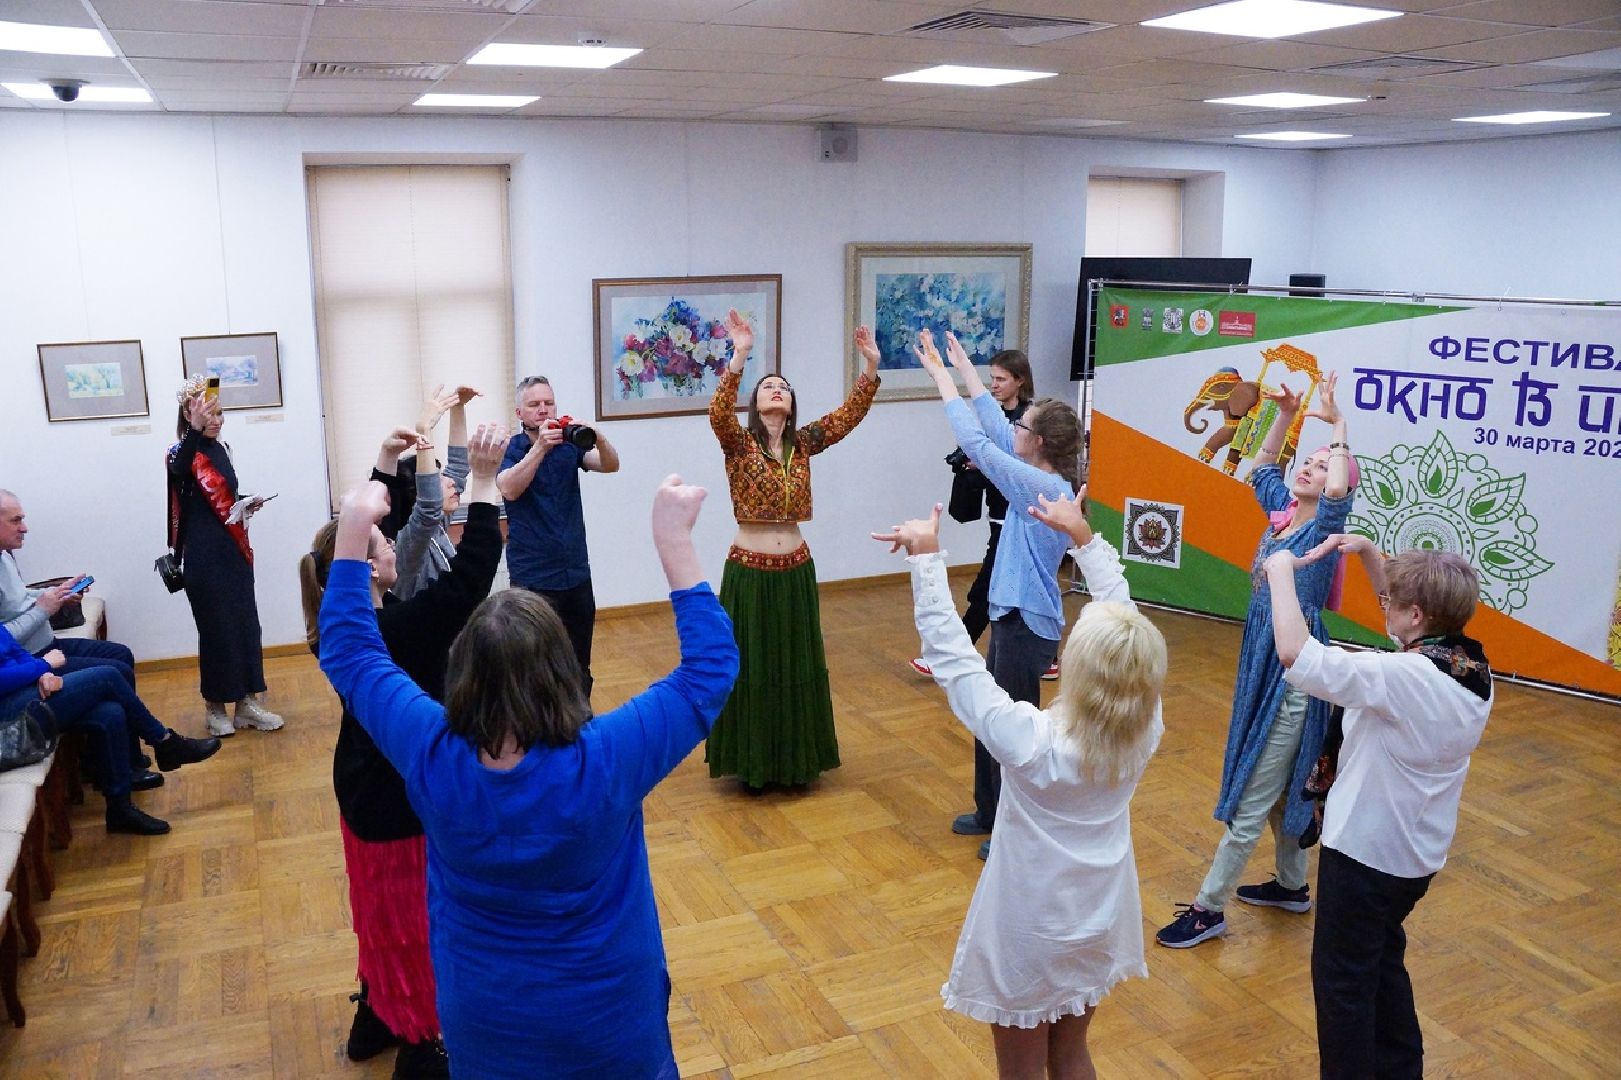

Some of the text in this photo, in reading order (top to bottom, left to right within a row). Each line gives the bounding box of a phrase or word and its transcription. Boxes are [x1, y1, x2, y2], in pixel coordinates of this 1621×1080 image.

[1429, 335, 1621, 371] ФЕСТИВ
[1353, 368, 1493, 425] ОКНО
[1579, 385, 1621, 435] И
[1474, 427, 1498, 445] 30
[1507, 434, 1575, 454] марта
